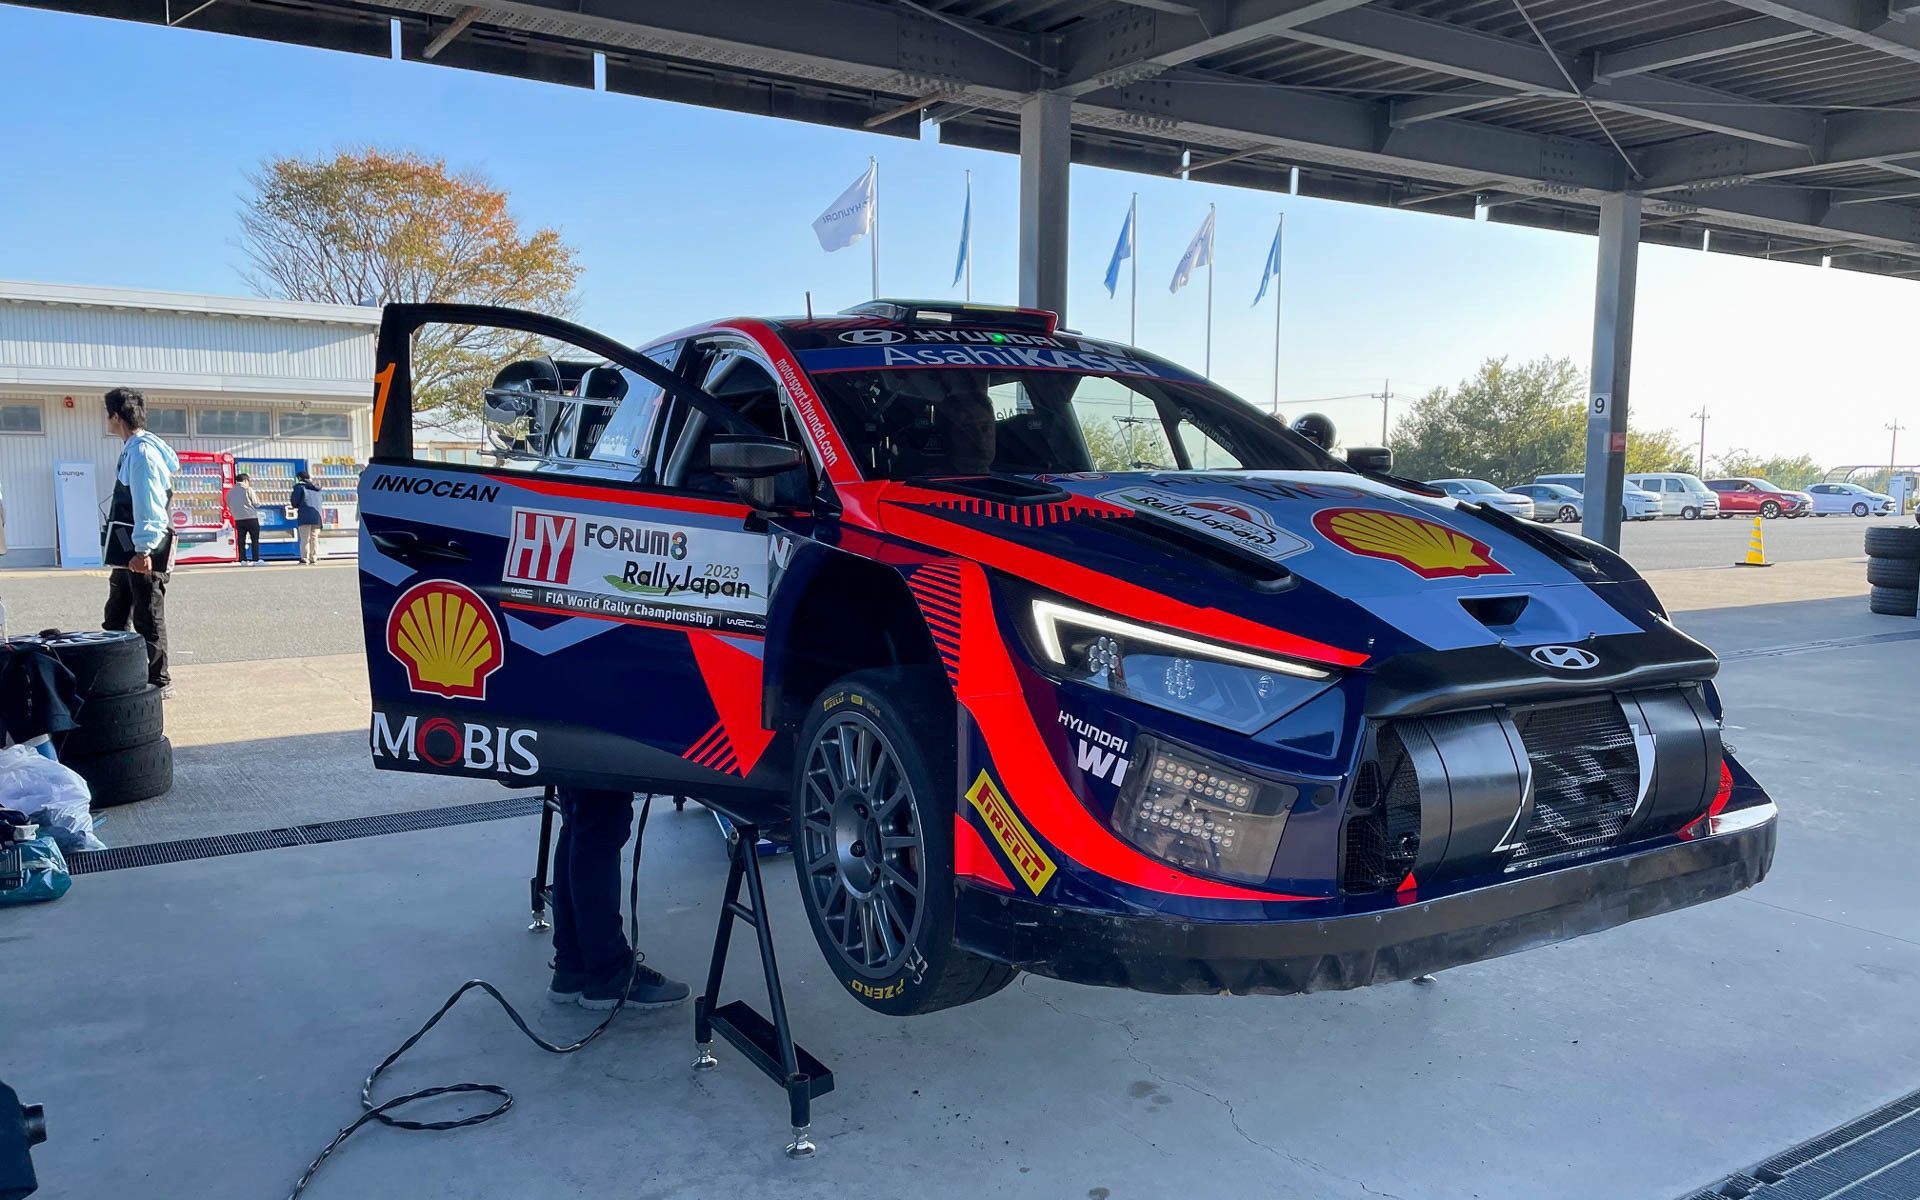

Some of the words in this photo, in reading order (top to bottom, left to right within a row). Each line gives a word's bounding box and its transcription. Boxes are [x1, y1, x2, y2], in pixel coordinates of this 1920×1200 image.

[884, 347, 1161, 378] AsahiKASEI
[777, 358, 838, 467] motorsport.hyundai.com
[1594, 397, 1606, 414] 9
[371, 474, 501, 503] INNOCEAN
[509, 513, 574, 582] HY
[584, 522, 688, 561] FORUM8
[704, 563, 740, 580] 2023
[545, 592, 565, 606] FIA
[567, 594, 600, 610] World
[603, 600, 632, 616] Rally
[634, 603, 714, 627] Championship
[372, 711, 540, 776] MOBIS
[1058, 709, 1129, 754] HYUNDAI
[976, 781, 1046, 882] PIRELLI
